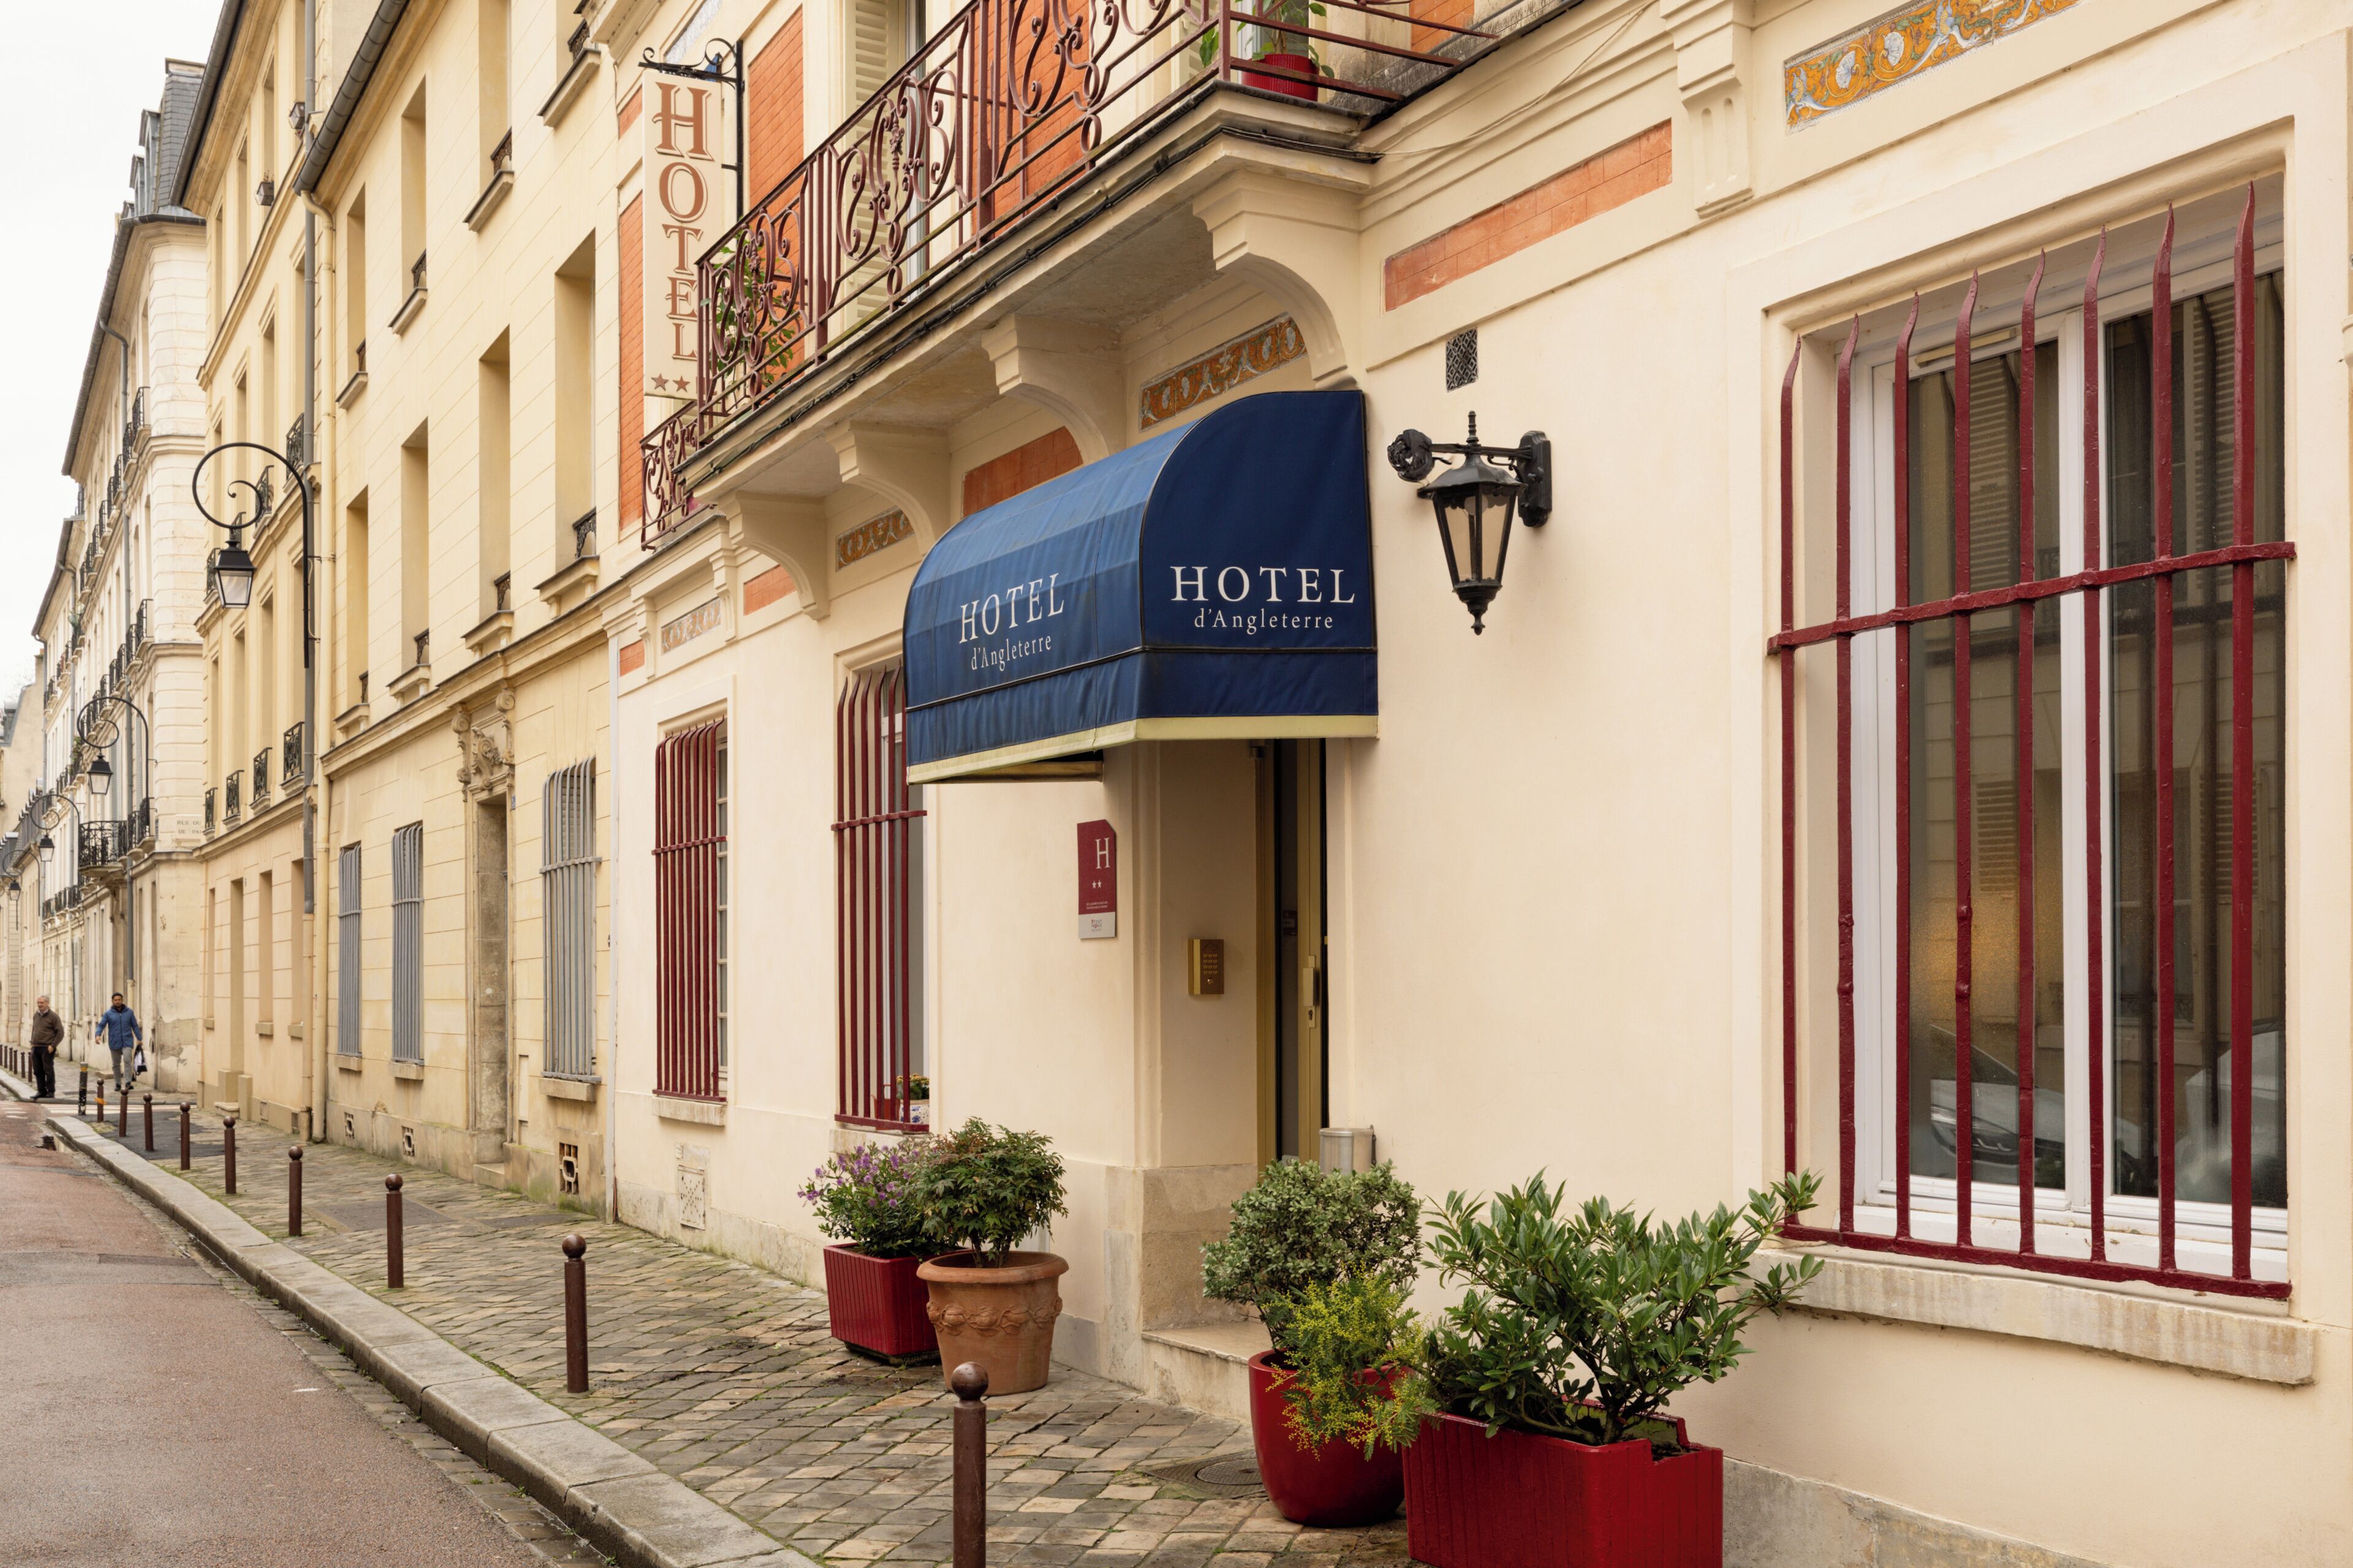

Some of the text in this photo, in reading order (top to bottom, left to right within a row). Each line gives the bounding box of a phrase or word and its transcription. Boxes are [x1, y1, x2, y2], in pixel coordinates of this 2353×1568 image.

[653, 81, 714, 360] HOTEL
[1170, 566, 1355, 602] HOTEL
[960, 573, 1064, 643] HOTEL
[1195, 608, 1333, 635] d'Angleterre
[971, 635, 1052, 672] d'Angleterre
[1095, 837, 1110, 869] H
